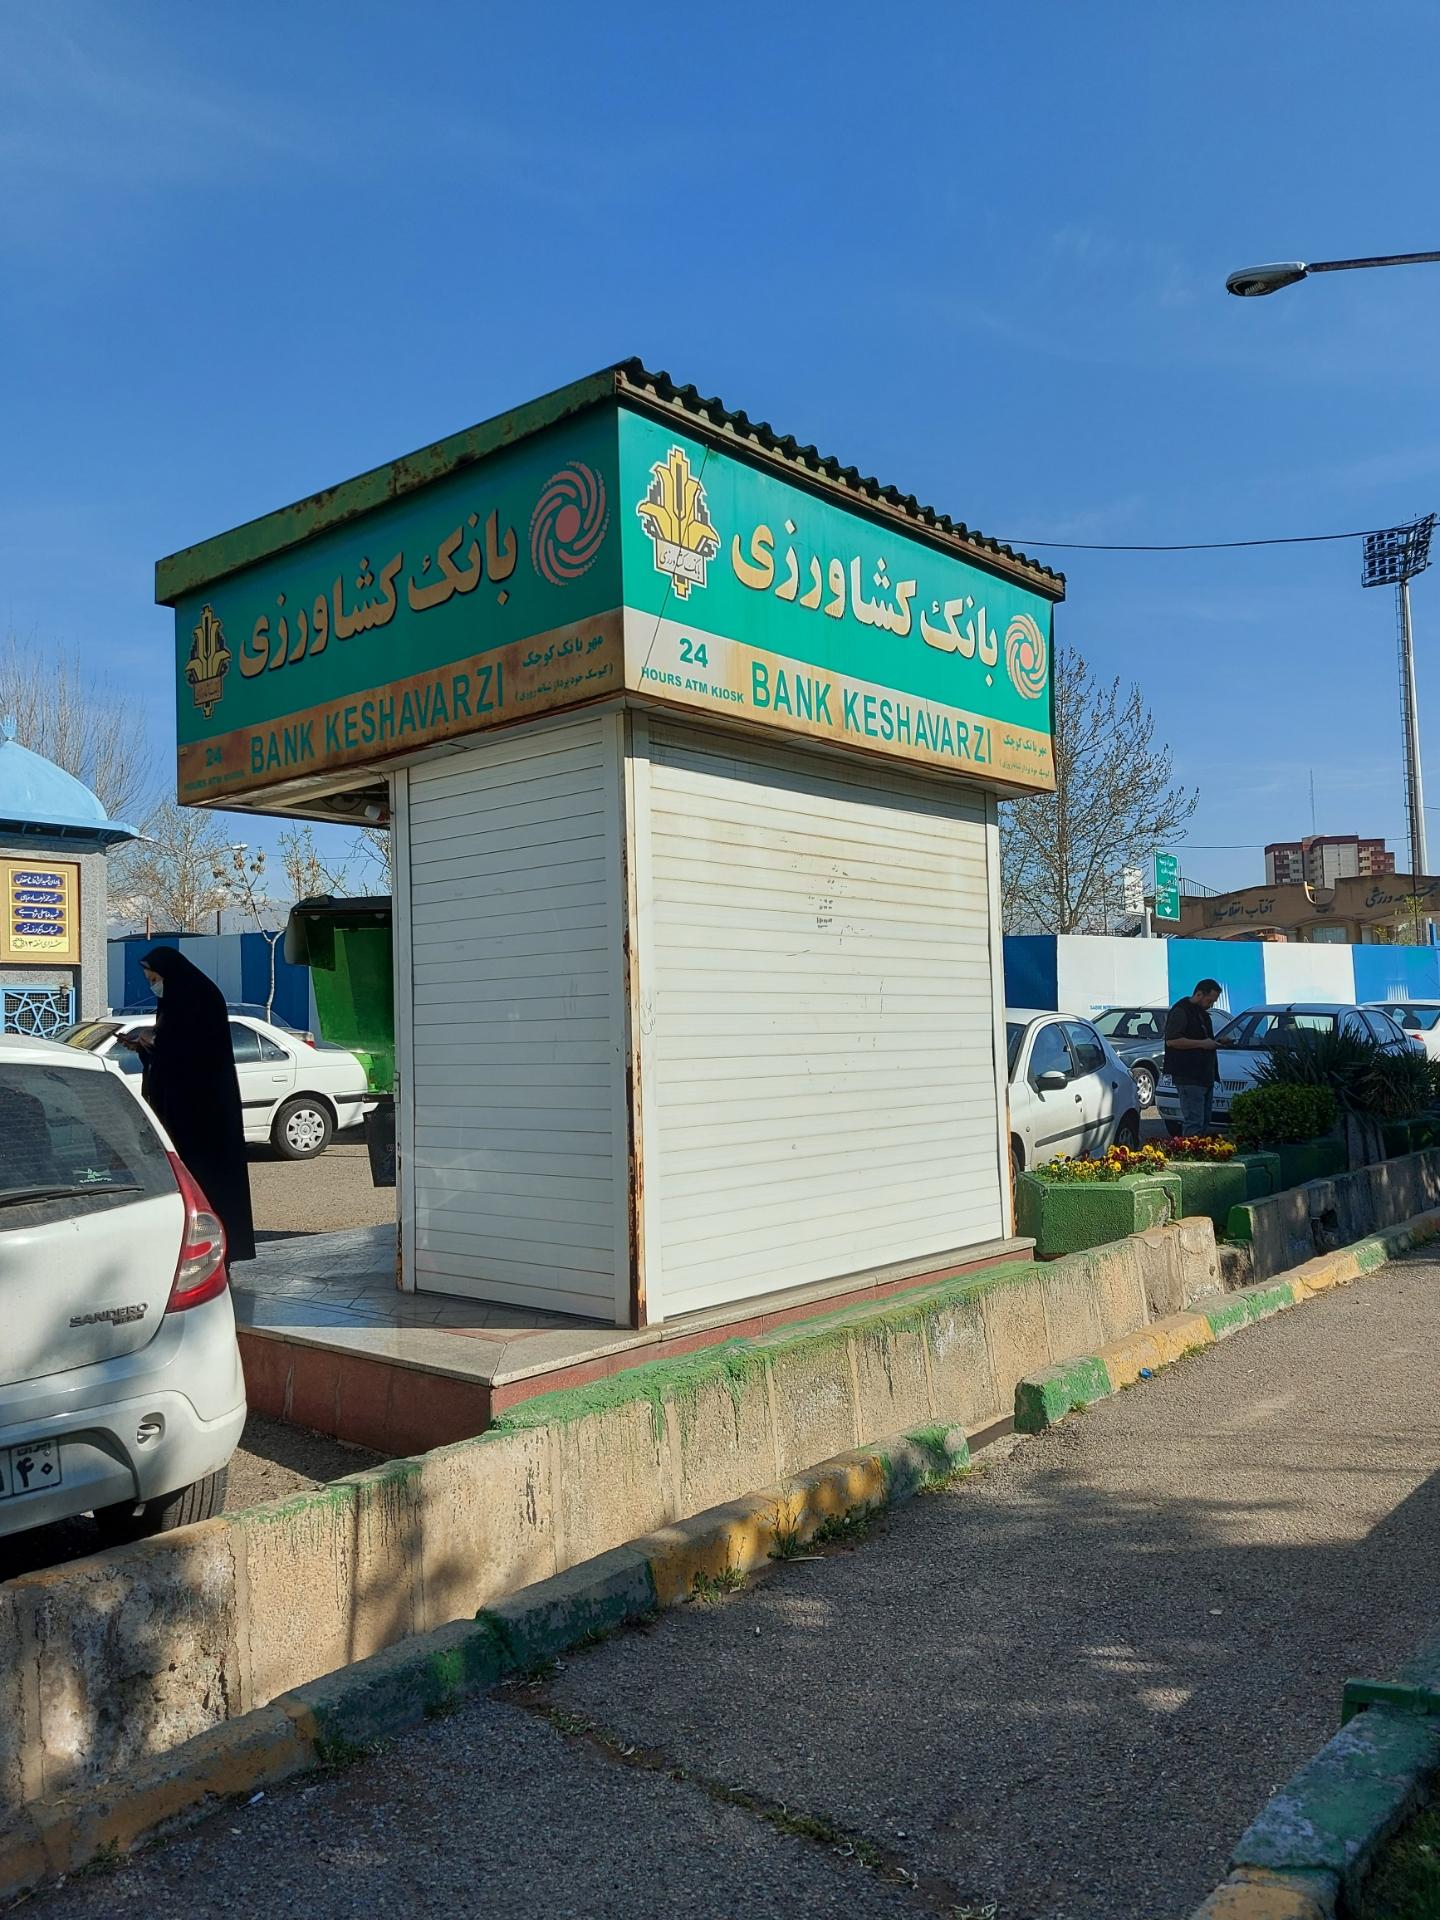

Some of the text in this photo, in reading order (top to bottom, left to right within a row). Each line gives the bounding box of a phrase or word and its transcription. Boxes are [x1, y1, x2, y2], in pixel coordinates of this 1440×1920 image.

[239, 508, 518, 679] بانک کشاورزی
[731, 519, 998, 688] بانک کشاورزی
[557, 636, 583, 657] بانک
[679, 637, 709, 668] 24
[641, 665, 745, 704] HOURS ATM KIOSK
[251, 662, 504, 775] BANK KESHAVARZI
[751, 660, 993, 764] BANK KESHAVARZI
[205, 745, 223, 768] 24
[1245, 898, 1276, 918] آفتاب
[1365, 886, 1393, 908] ورزشی
[69, 1302, 149, 1328] SANDERO
[16, 1456, 54, 1488] ۴۰
